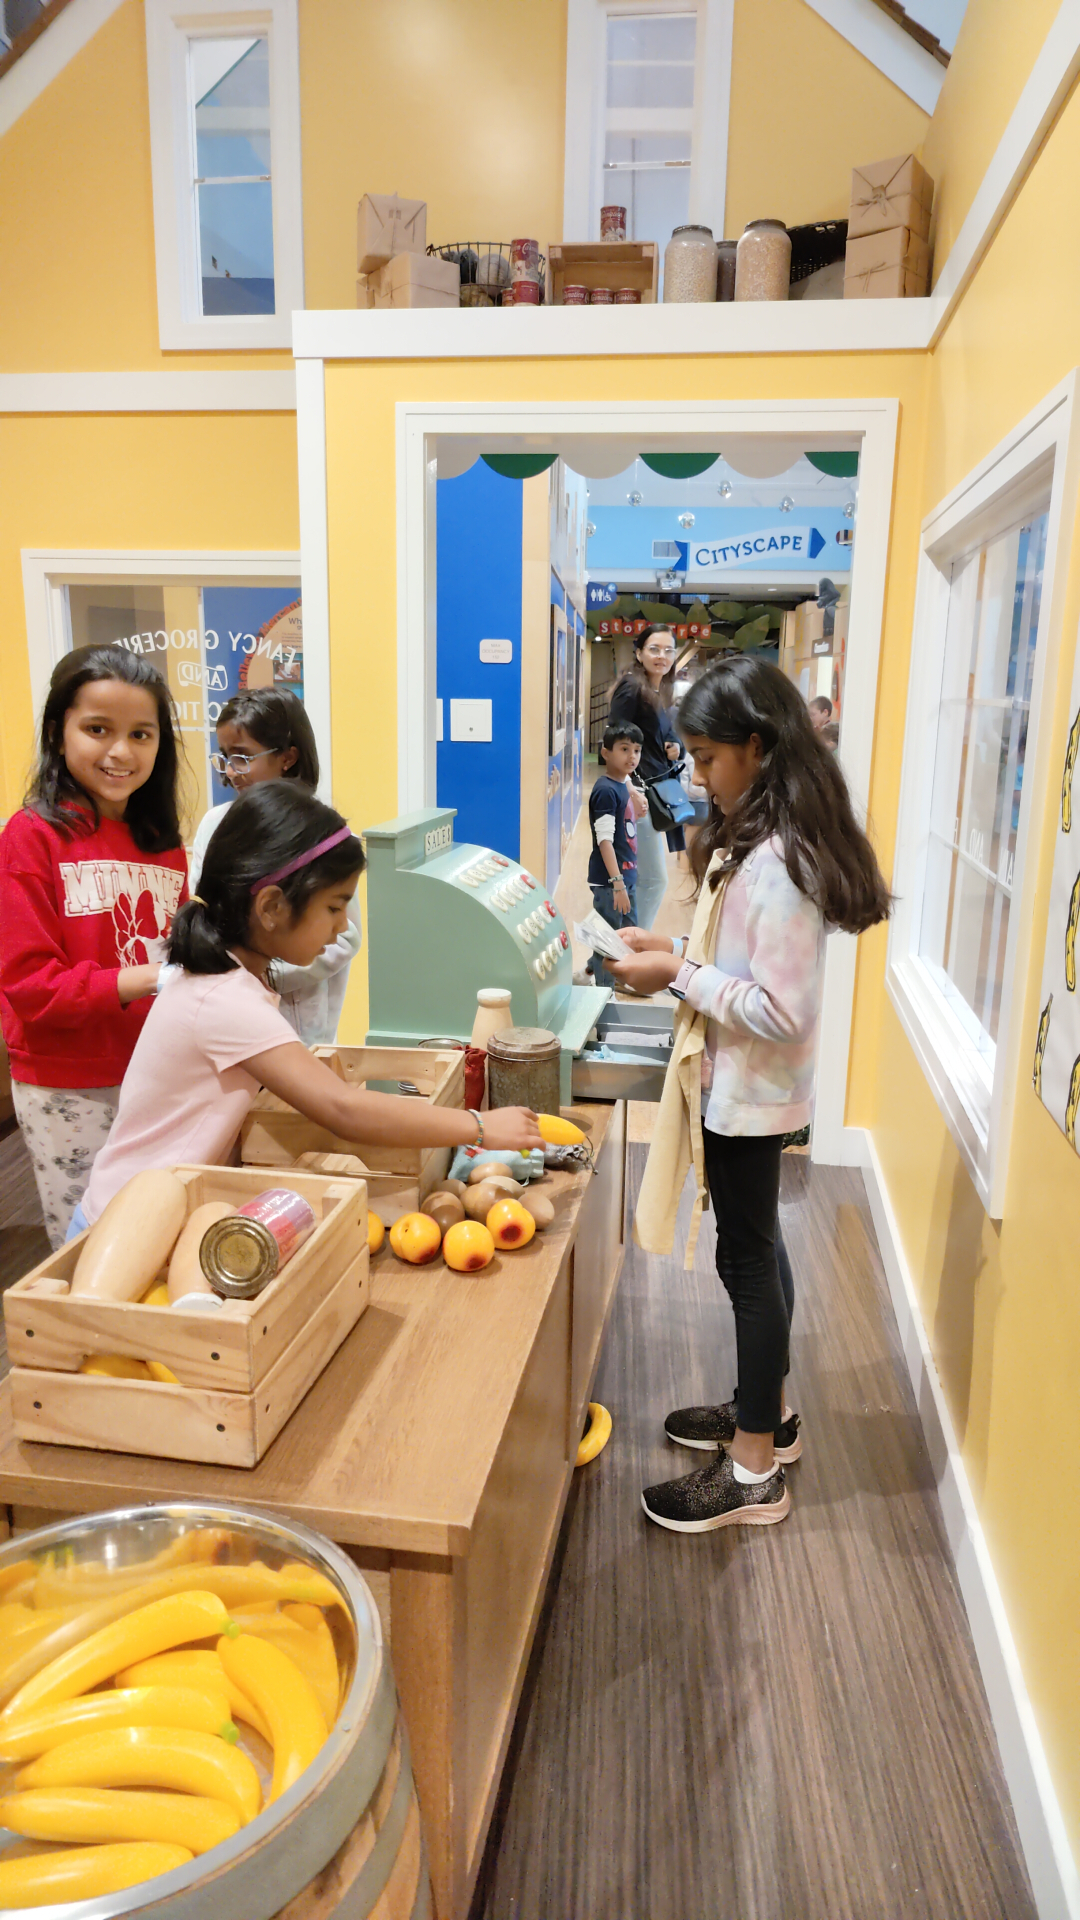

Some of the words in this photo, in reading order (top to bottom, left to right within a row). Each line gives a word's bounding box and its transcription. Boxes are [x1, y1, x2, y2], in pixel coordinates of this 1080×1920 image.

[695, 535, 803, 567] CITYSCAPE
[601, 621, 653, 634] Stor
[427, 827, 451, 851] SALES
[59, 860, 186, 918] MINNIE
